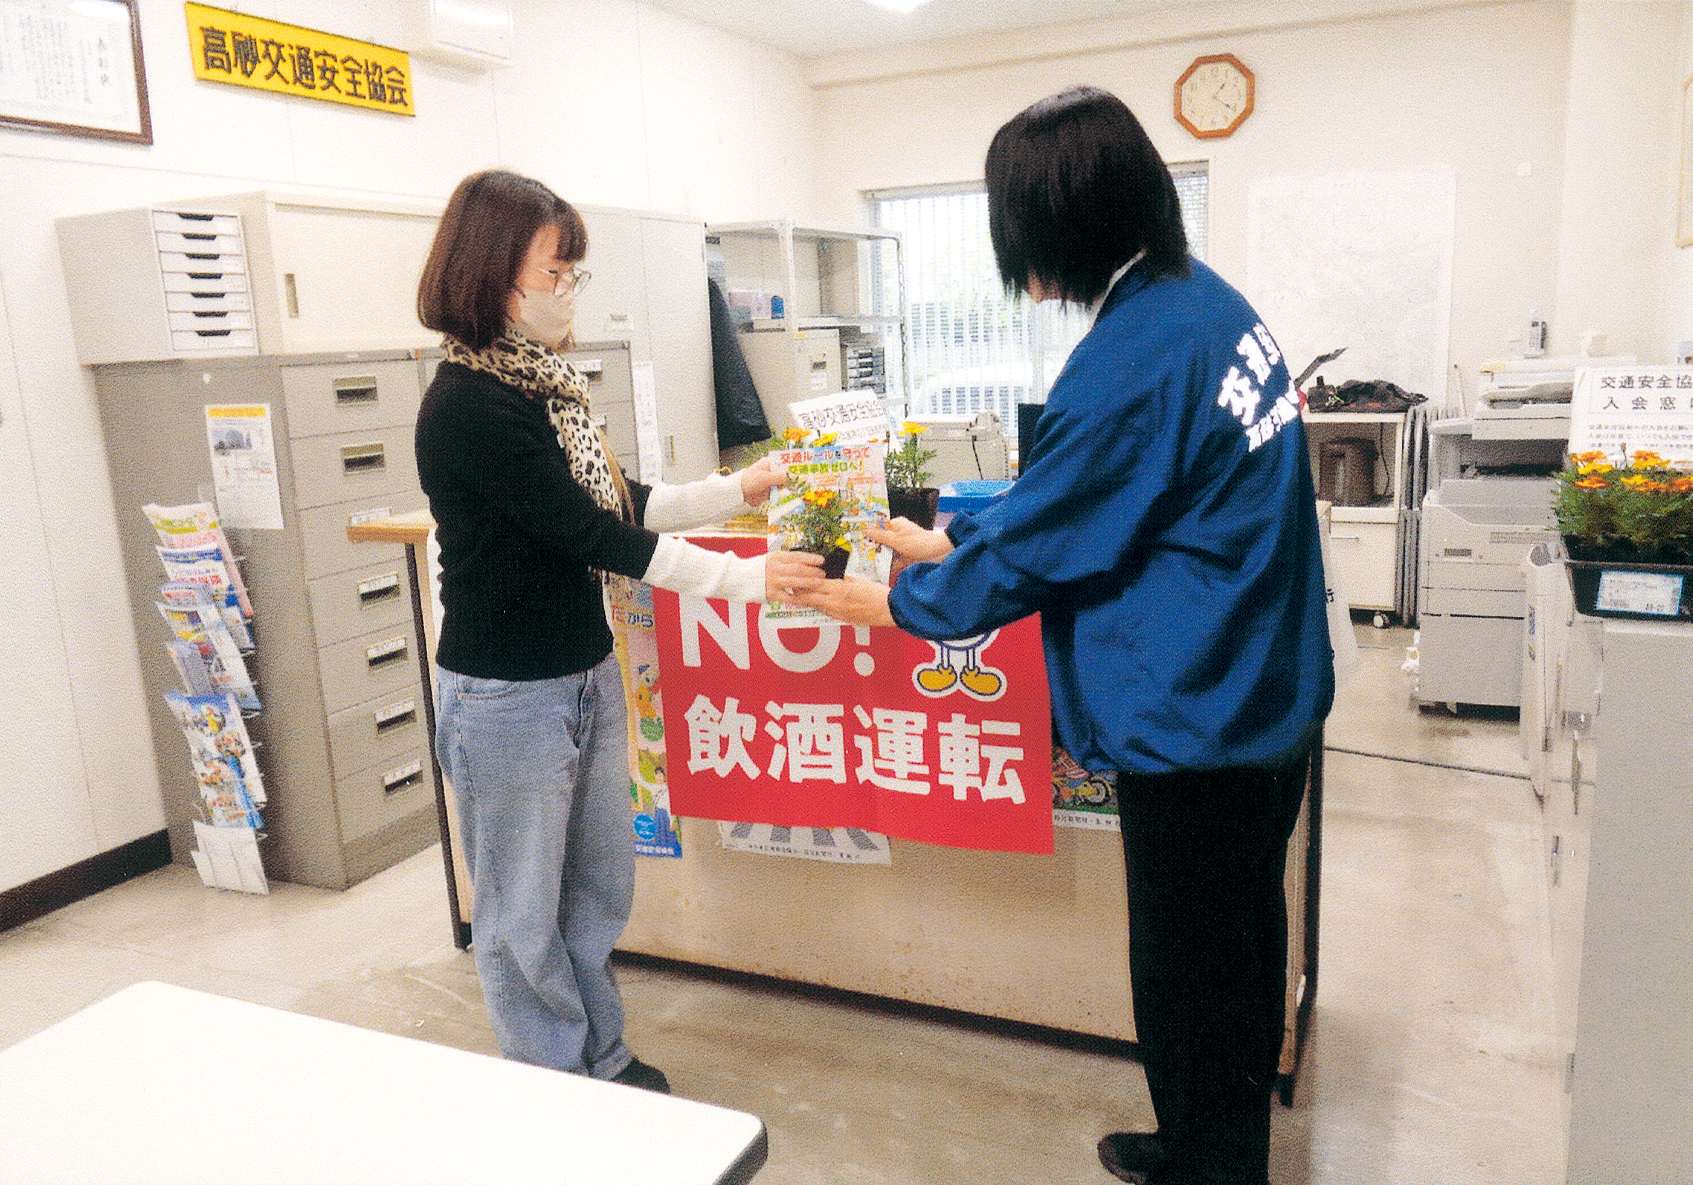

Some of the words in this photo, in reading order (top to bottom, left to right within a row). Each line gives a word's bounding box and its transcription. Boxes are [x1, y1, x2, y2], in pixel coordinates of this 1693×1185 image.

[199, 26, 409, 107] 高砂交通安全協会
[1603, 396, 1693, 410] 入会窓
[780, 447, 870, 464] 交通ルールを守って
[684, 694, 1026, 804] 飲酒運転
